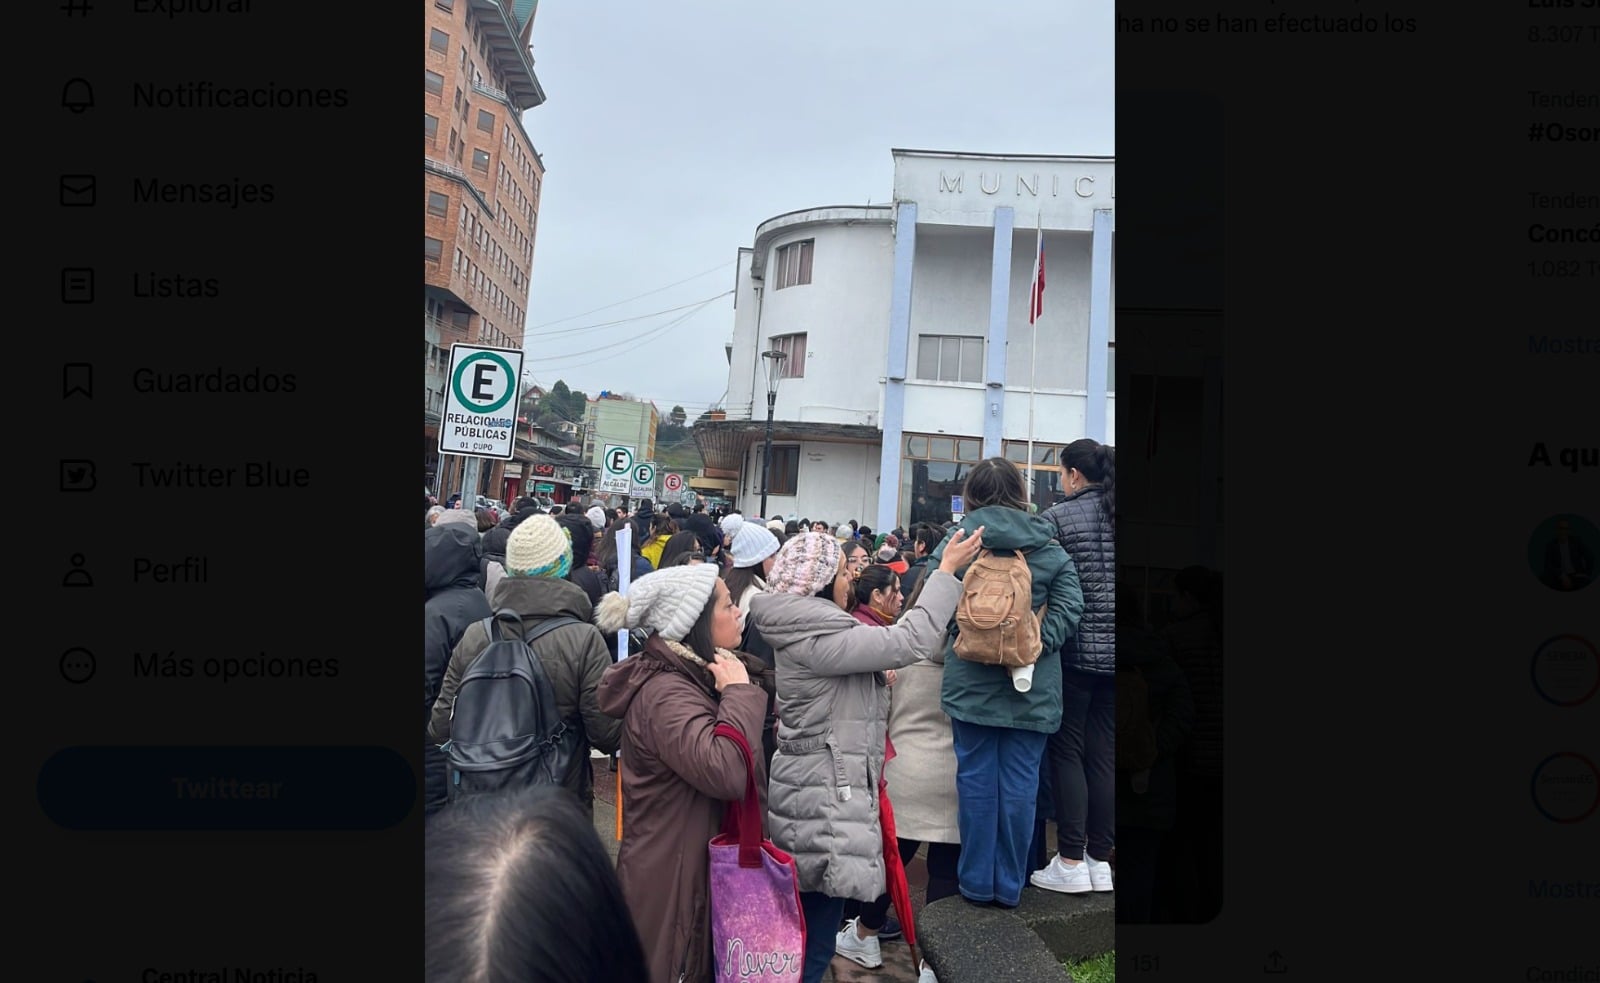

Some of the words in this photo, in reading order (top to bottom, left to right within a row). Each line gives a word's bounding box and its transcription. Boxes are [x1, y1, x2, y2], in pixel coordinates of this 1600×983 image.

[1117, 12, 1144, 32] ha
[1151, 17, 1178, 32] no
[1185, 17, 1210, 32] se
[1216, 12, 1257, 32] han
[1264, 12, 1378, 32] efectuado
[1384, 12, 1416, 32] los
[1528, 25, 1583, 43] 8.307
[133, 81, 348, 108] Notificaciones
[133, 178, 274, 209] Mensajes
[1528, 260, 1580, 277] 1.082
[133, 272, 219, 298] Listas
[133, 367, 296, 393] Guardados
[471, 363, 497, 401] E
[447, 413, 512, 428] RELACIONE
[454, 425, 507, 441] PÚBLICAS
[612, 451, 626, 471] E
[1527, 443, 1553, 467] A
[132, 461, 236, 487] Twitter
[246, 461, 310, 487] Blue
[134, 557, 208, 583] Perfil
[134, 651, 194, 677] Más
[203, 652, 339, 683] opciones
[172, 777, 283, 799] Twittear
[1130, 954, 1160, 972] 151
[141, 967, 228, 983] Central
[235, 967, 318, 983] Noticia
